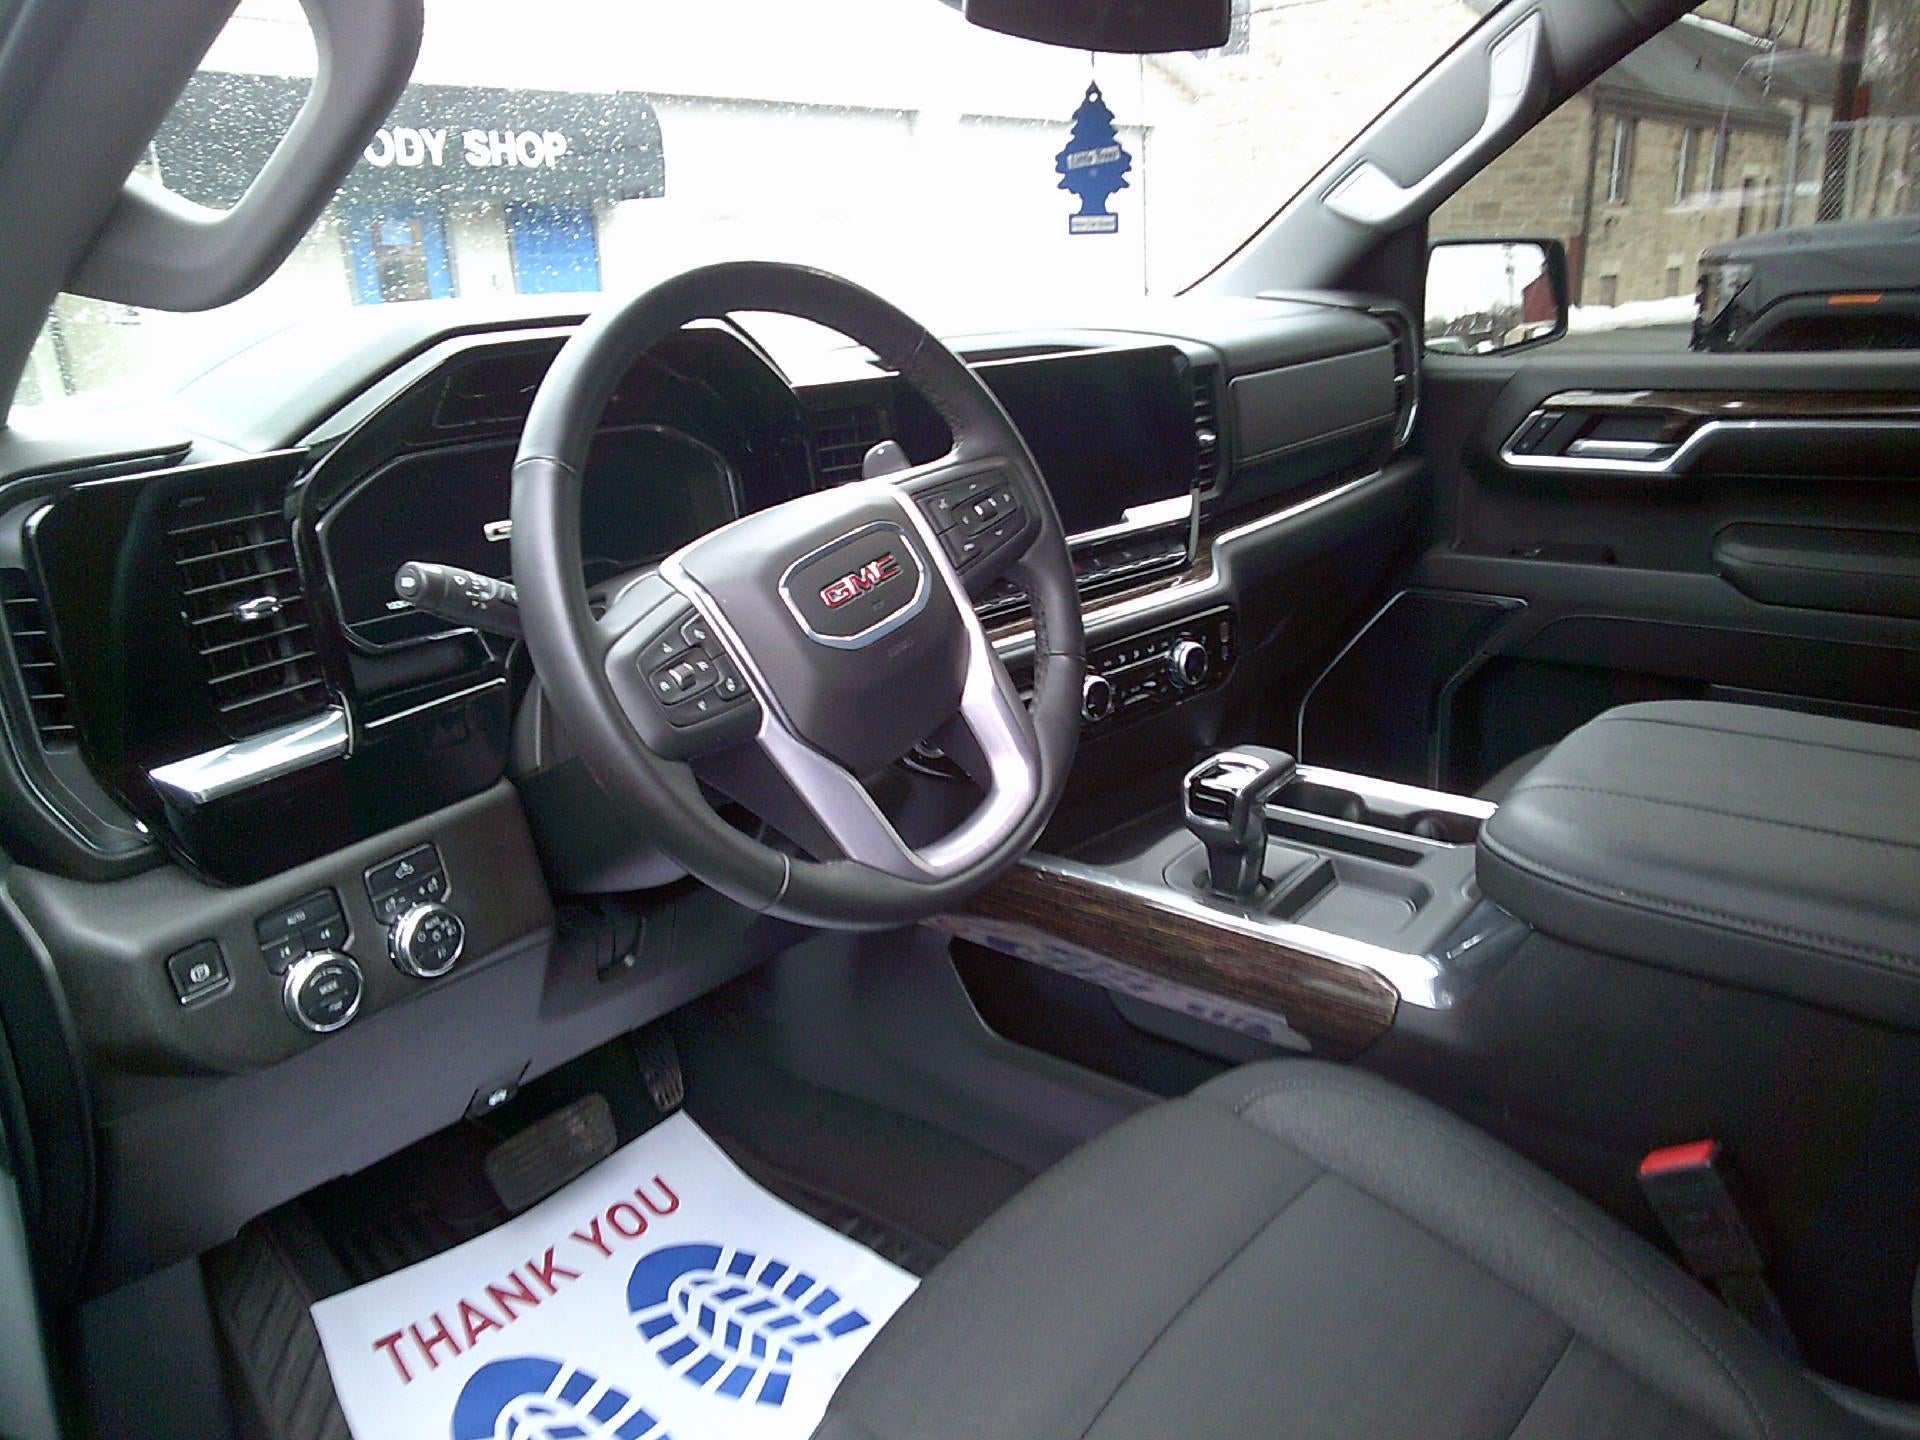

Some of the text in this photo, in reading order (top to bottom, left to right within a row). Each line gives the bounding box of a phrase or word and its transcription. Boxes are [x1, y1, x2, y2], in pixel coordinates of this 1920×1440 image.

[363, 126, 567, 168] ODY SHOP
[820, 551, 902, 608] GMC
[373, 1174, 681, 1384] THANK YOU
